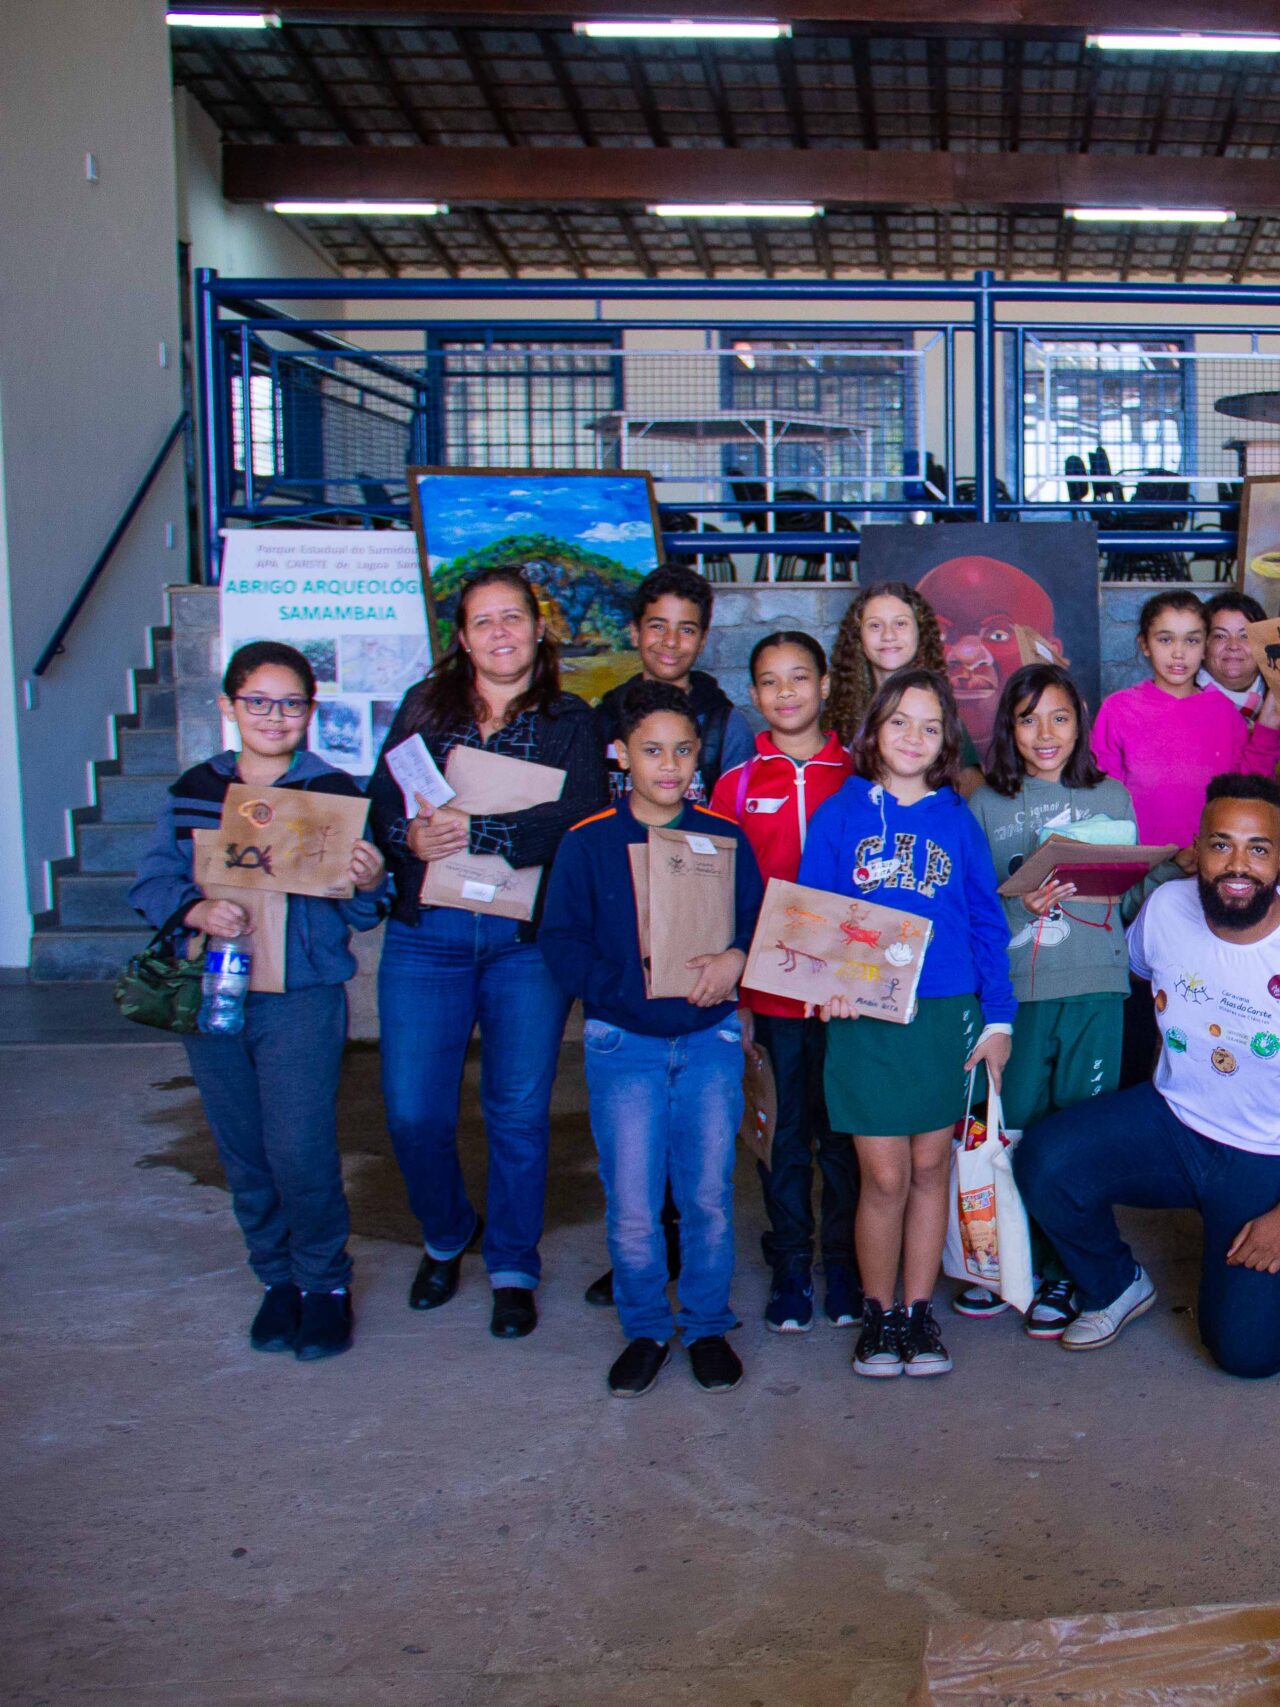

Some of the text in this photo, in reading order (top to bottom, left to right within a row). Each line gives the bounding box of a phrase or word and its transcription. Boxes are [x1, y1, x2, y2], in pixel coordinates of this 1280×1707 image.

[225, 576, 420, 595] ABRIGO ARQUEOLÓG
[279, 605, 397, 621] SAMAMBAIA
[855, 832, 953, 899] GAP
[1220, 997, 1272, 1019] Asas do Carste
